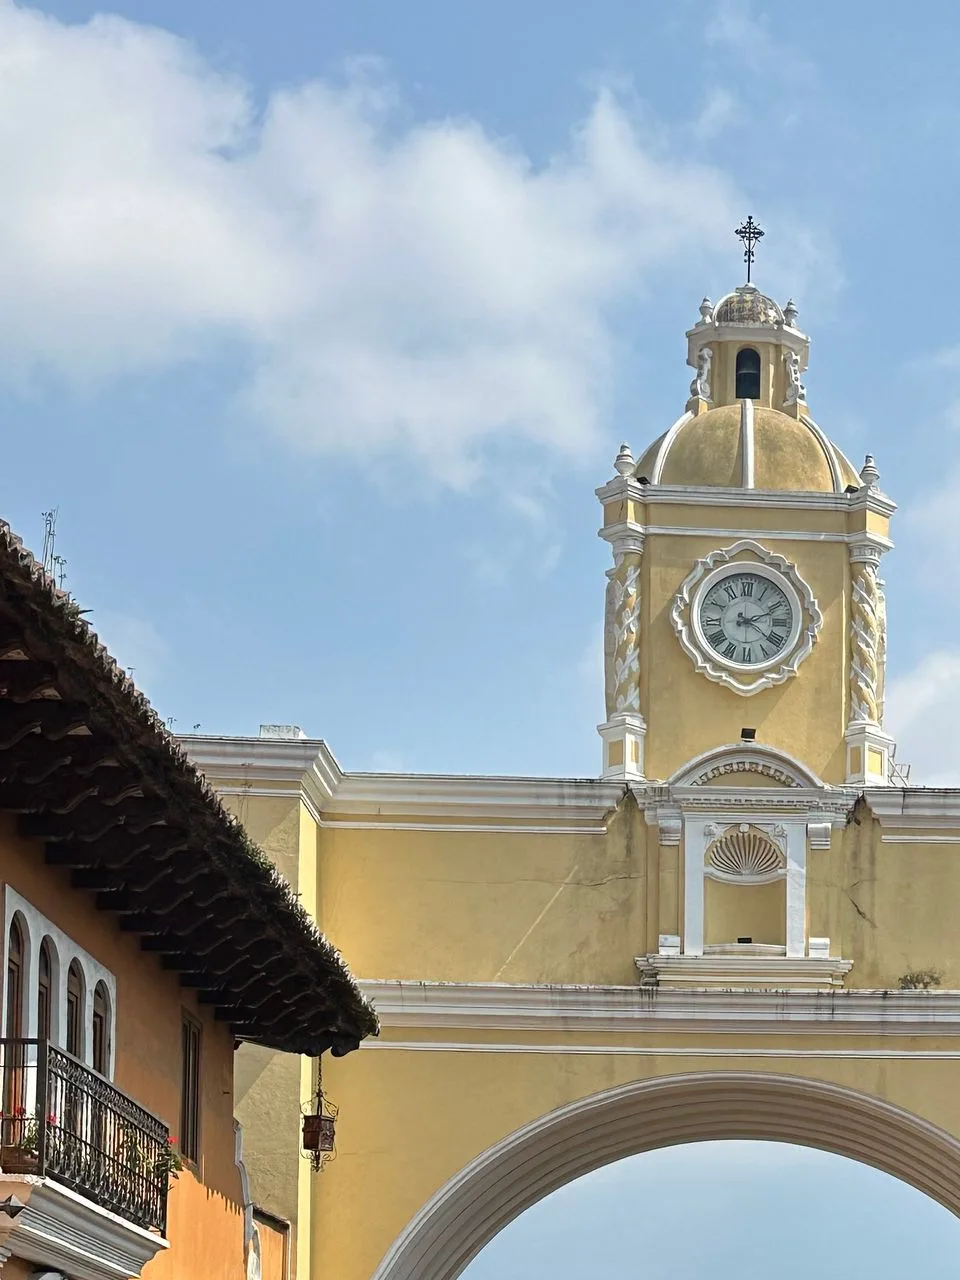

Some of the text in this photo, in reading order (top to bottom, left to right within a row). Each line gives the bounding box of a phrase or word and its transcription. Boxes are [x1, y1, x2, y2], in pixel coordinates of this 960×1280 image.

[723, 585, 738, 601] XI
[740, 581, 754, 597] XII
[757, 587, 768, 601] I
[711, 598, 726, 612] X
[706, 617, 721, 627] IX
[772, 618, 787, 627] III
[722, 642, 737, 658] VII
[742, 647, 752, 662] VI
[759, 644, 769, 658] V
